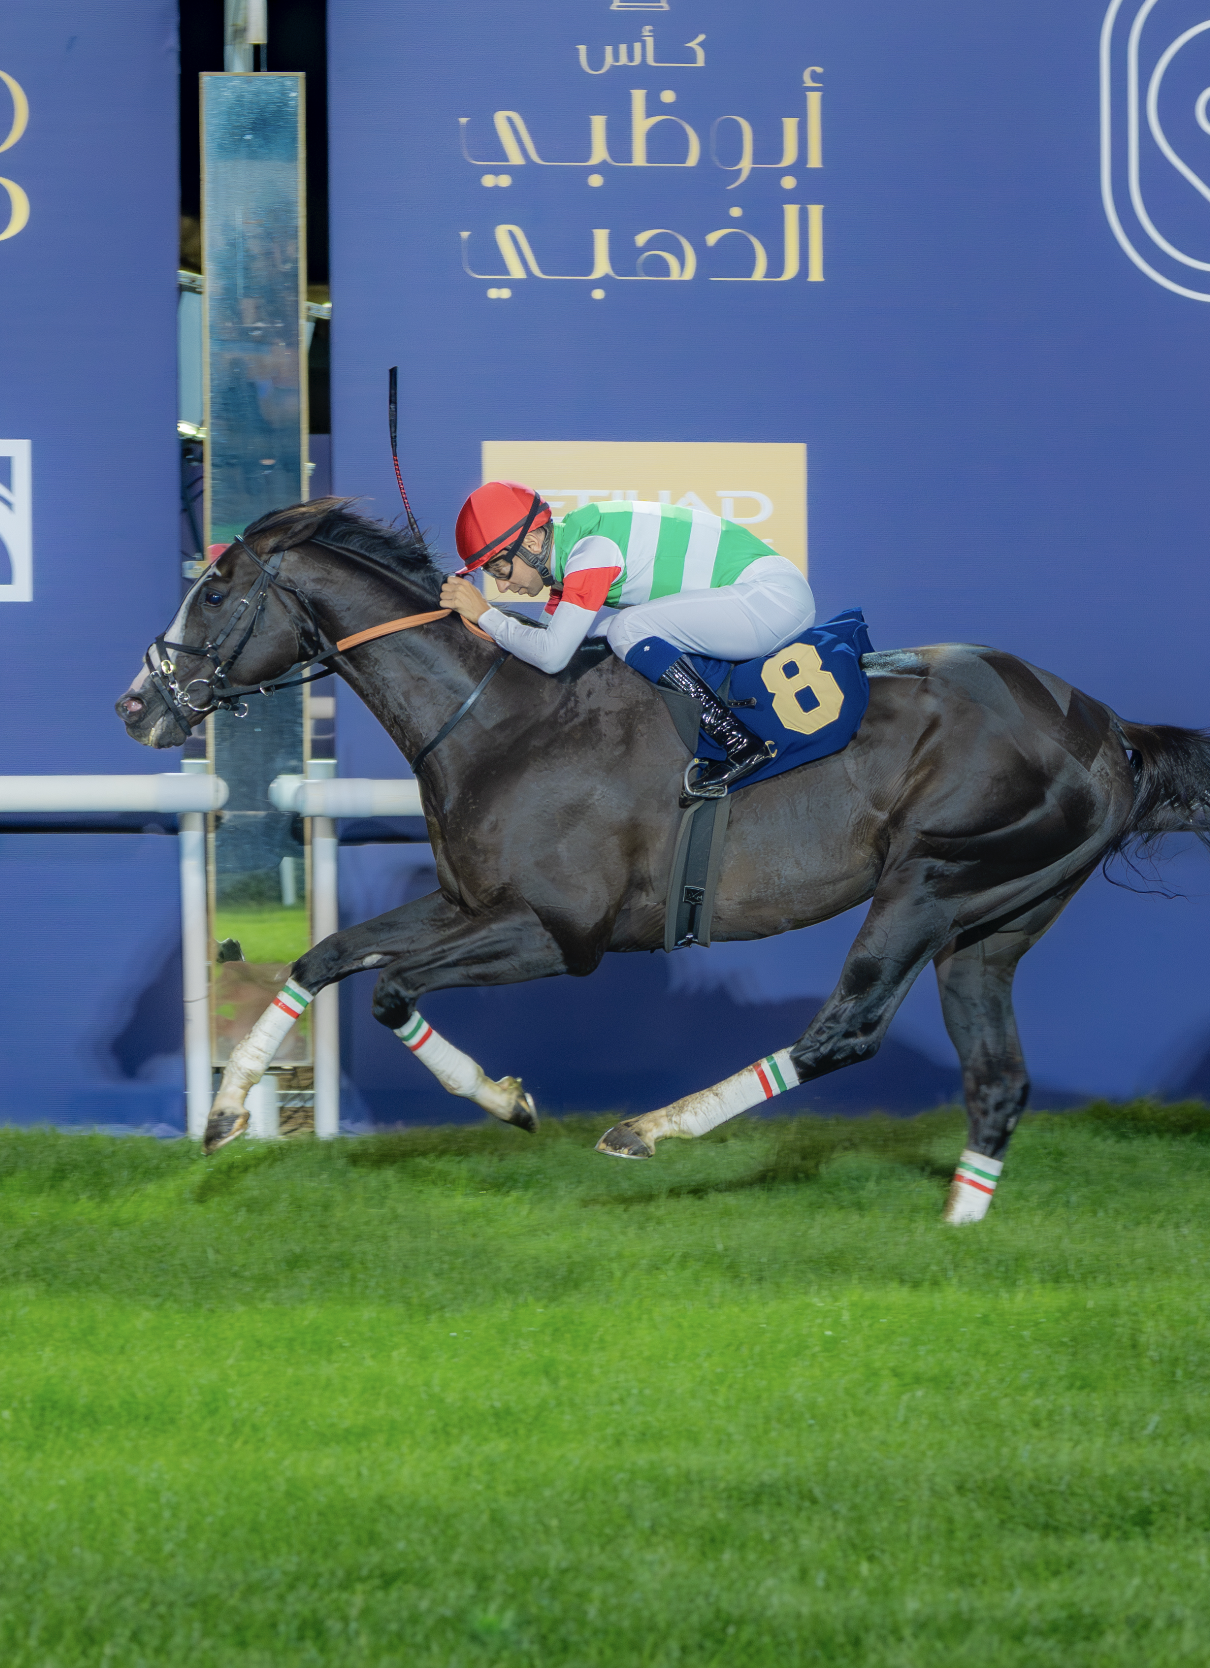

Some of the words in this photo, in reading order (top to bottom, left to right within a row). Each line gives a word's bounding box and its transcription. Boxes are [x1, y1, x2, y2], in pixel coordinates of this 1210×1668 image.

[575, 25, 706, 75] كأس
[458, 204, 825, 300] الذهبي
[760, 642, 845, 735] 8
